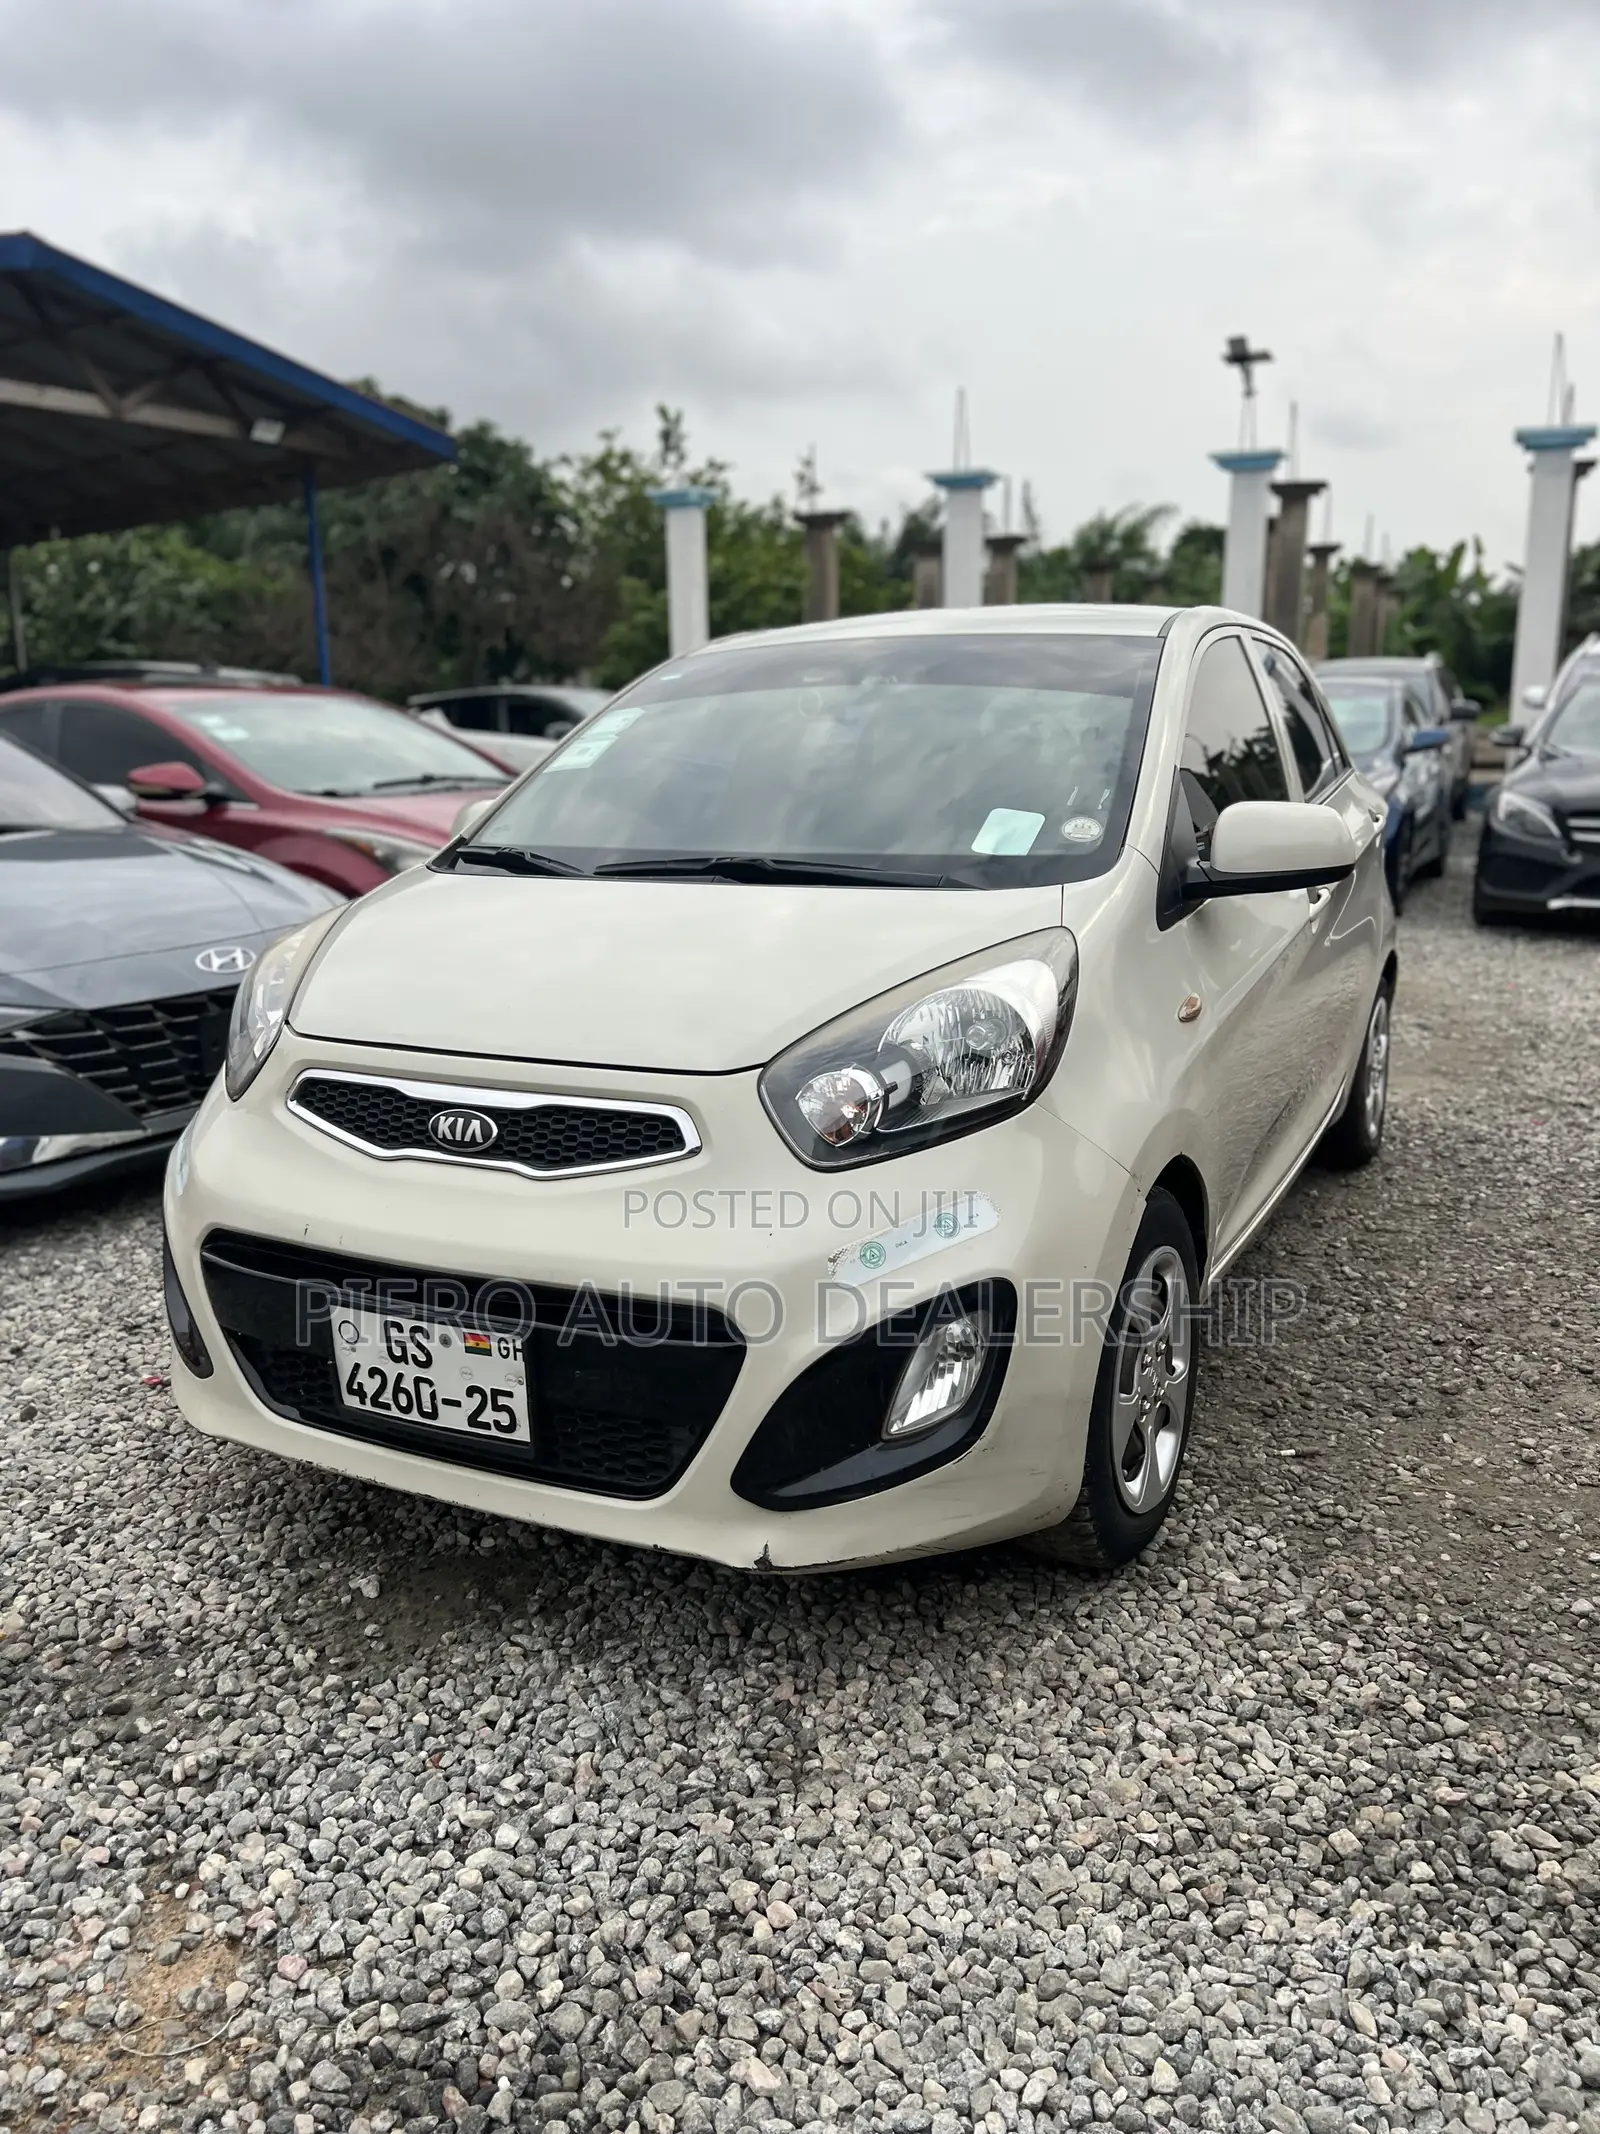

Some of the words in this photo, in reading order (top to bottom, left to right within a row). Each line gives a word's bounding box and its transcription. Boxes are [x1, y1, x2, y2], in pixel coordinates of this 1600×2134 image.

[437, 1115, 484, 1143] KIA
[383, 1320, 433, 1369] GS
[497, 1337, 525, 1362] GH
